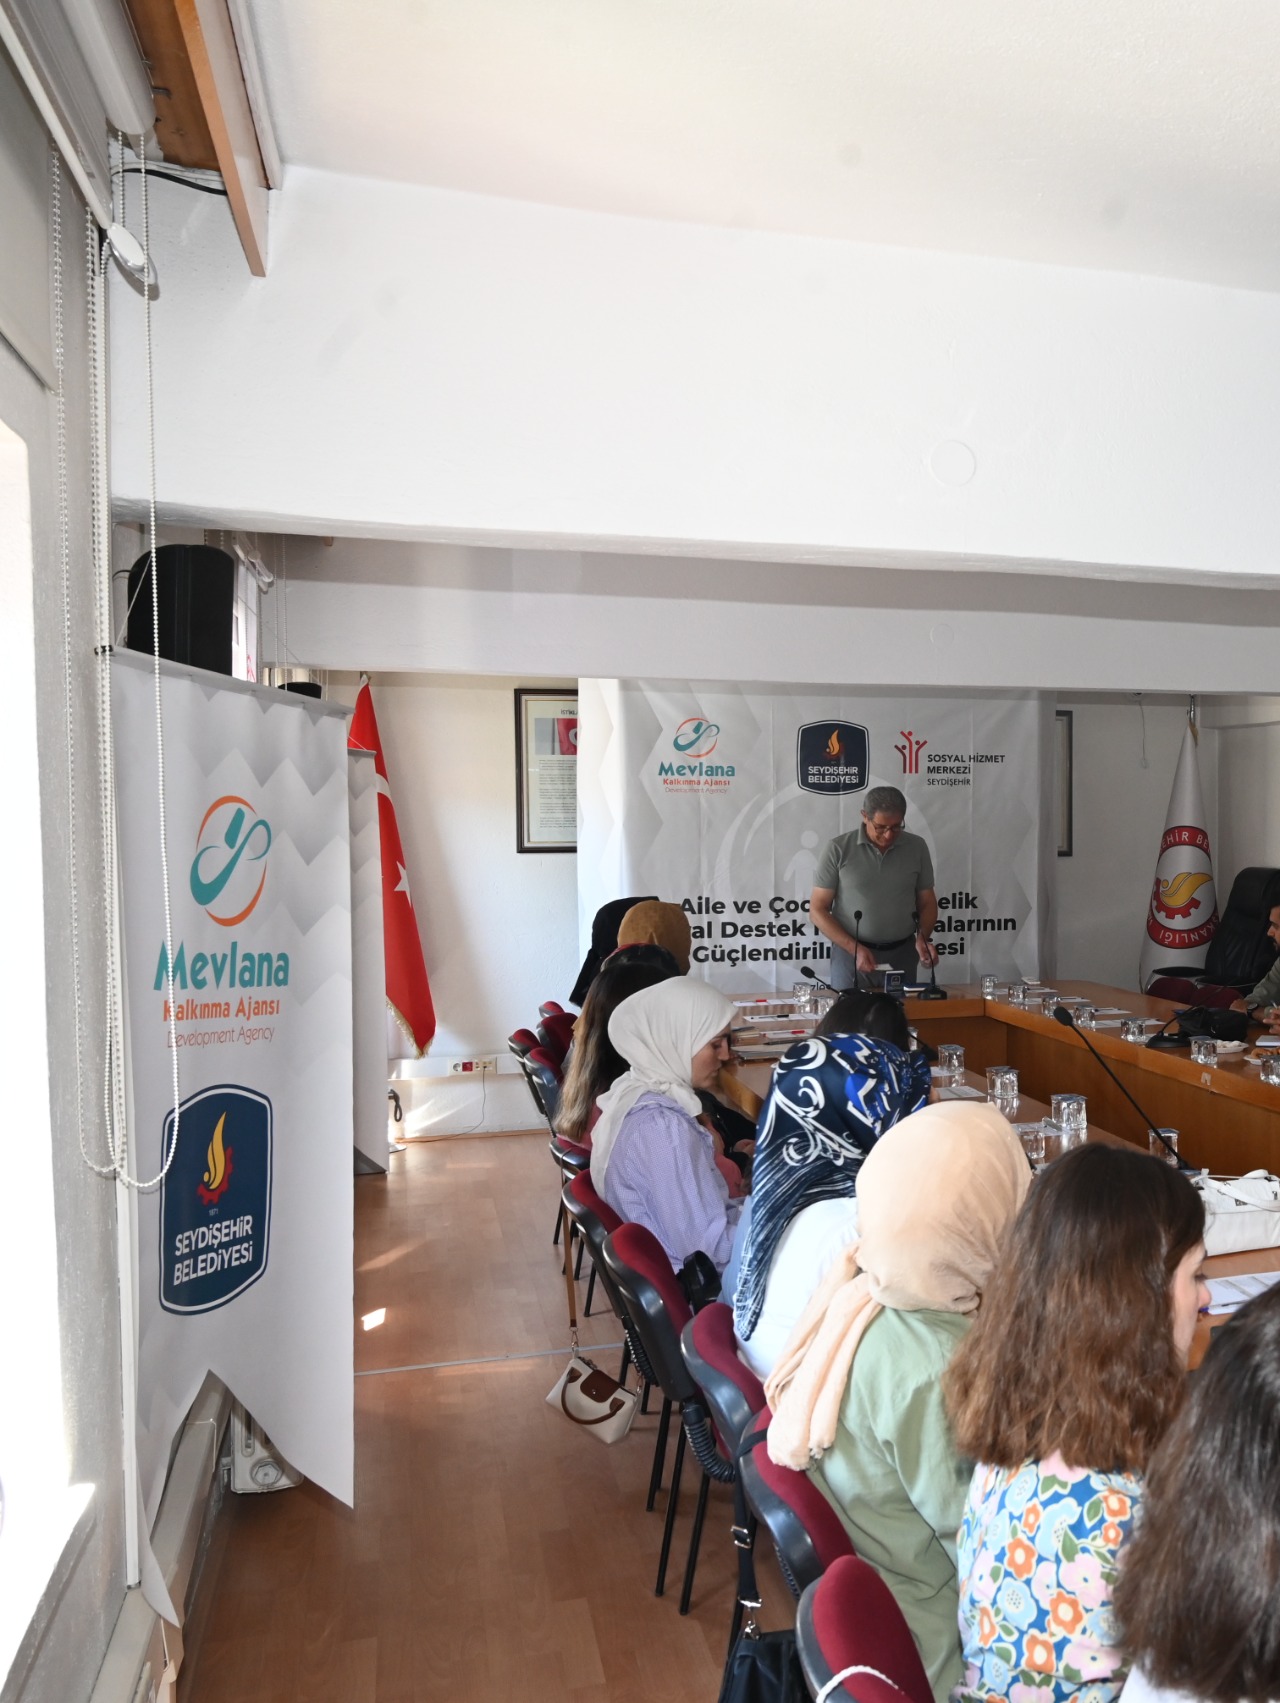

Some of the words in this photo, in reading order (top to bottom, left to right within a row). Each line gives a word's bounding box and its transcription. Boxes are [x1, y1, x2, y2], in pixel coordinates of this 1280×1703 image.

[927, 754, 966, 763] SOSYAL
[968, 752, 1006, 763] HİZMET
[658, 761, 736, 777] Mevlana
[927, 764, 971, 775] MERKEZİ
[663, 778, 701, 786] Kalkınma
[703, 778, 730, 787] Ajansı
[927, 777, 971, 787] SEYDİŞEHİR
[682, 895, 726, 915] Aile
[733, 900, 762, 914] ve
[769, 896, 811, 919] Çoc
[938, 891, 978, 910] elik
[721, 919, 806, 939] Destek
[933, 915, 1017, 933] alarının
[692, 941, 831, 967] Güçlendiril
[937, 937, 965, 955] esi
[153, 940, 290, 991] Mevlana
[235, 996, 280, 1021] Ajansı
[167, 1027, 236, 1048] Development
[237, 1026, 275, 1045] Agency
